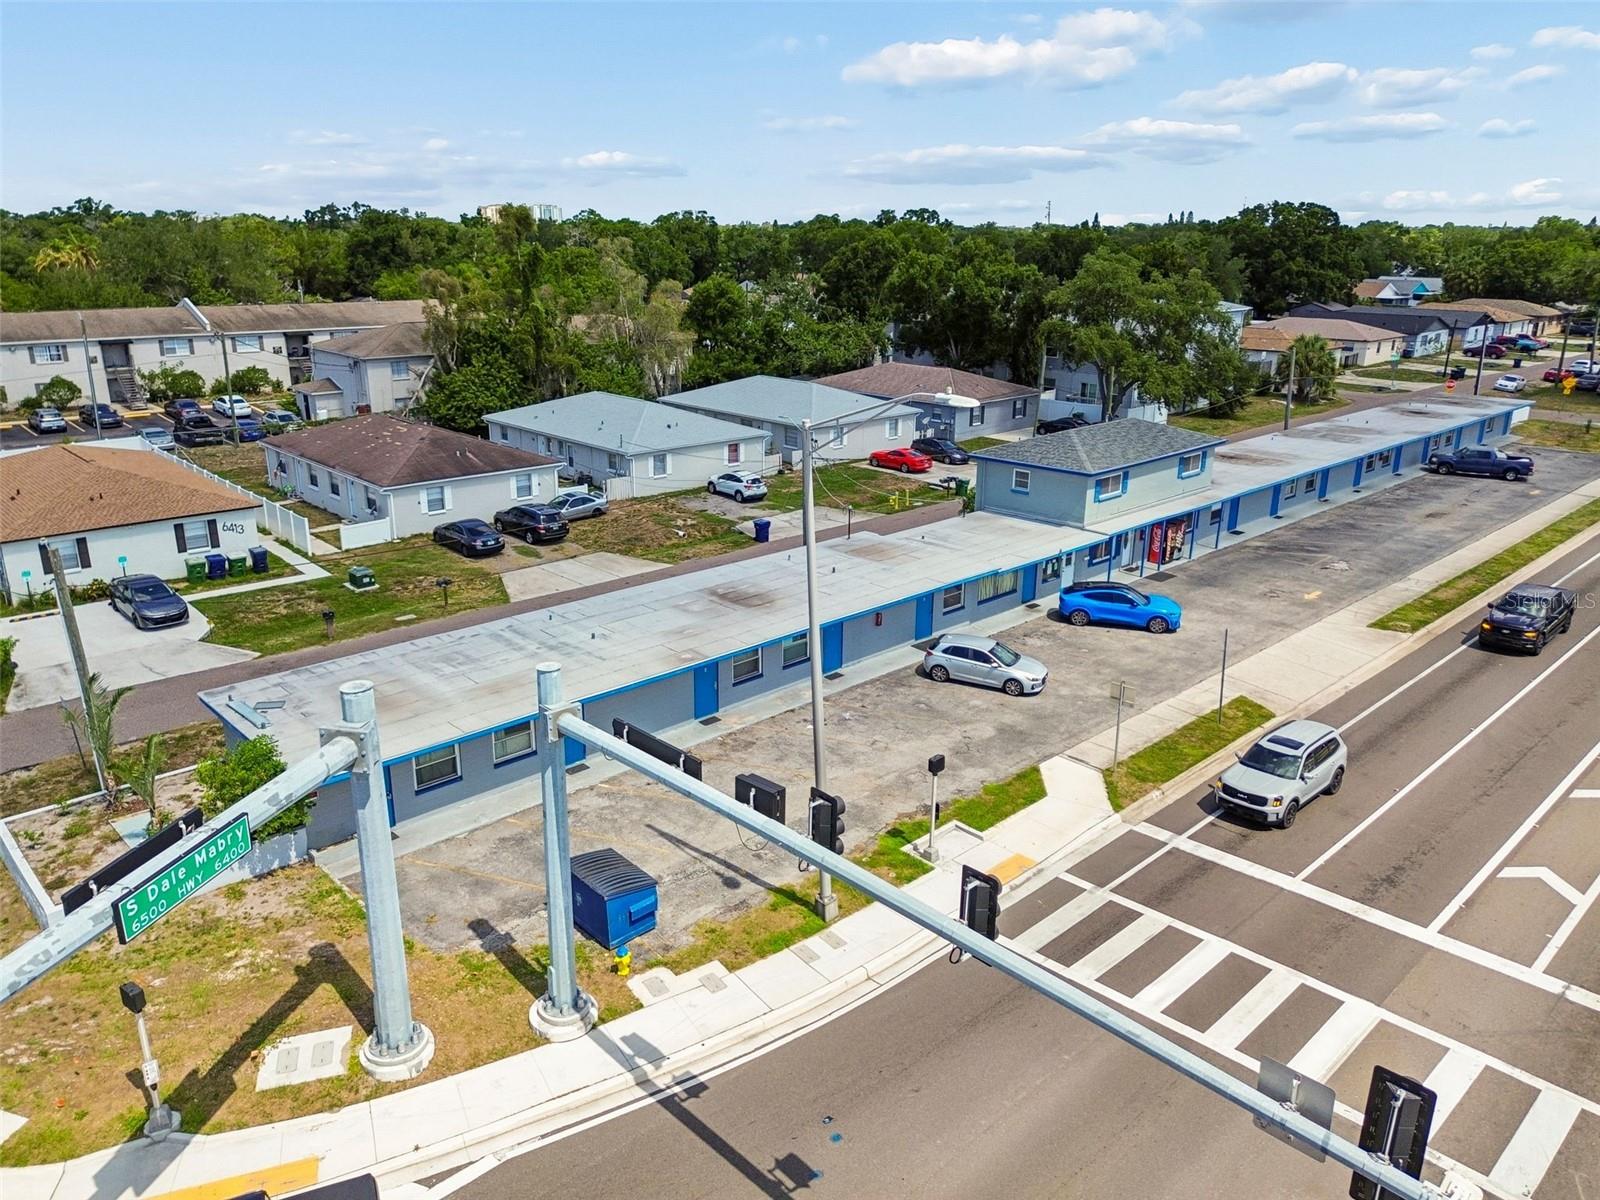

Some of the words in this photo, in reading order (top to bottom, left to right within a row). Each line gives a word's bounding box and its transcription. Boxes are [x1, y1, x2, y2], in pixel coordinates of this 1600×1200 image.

[222, 522, 245, 534] 6413
[126, 899, 138, 917] S
[147, 868, 187, 902] Dale
[194, 825, 243, 867] Mabry
[132, 899, 167, 932] 6500
[178, 871, 204, 898] HWY
[215, 843, 245, 870] 6400
